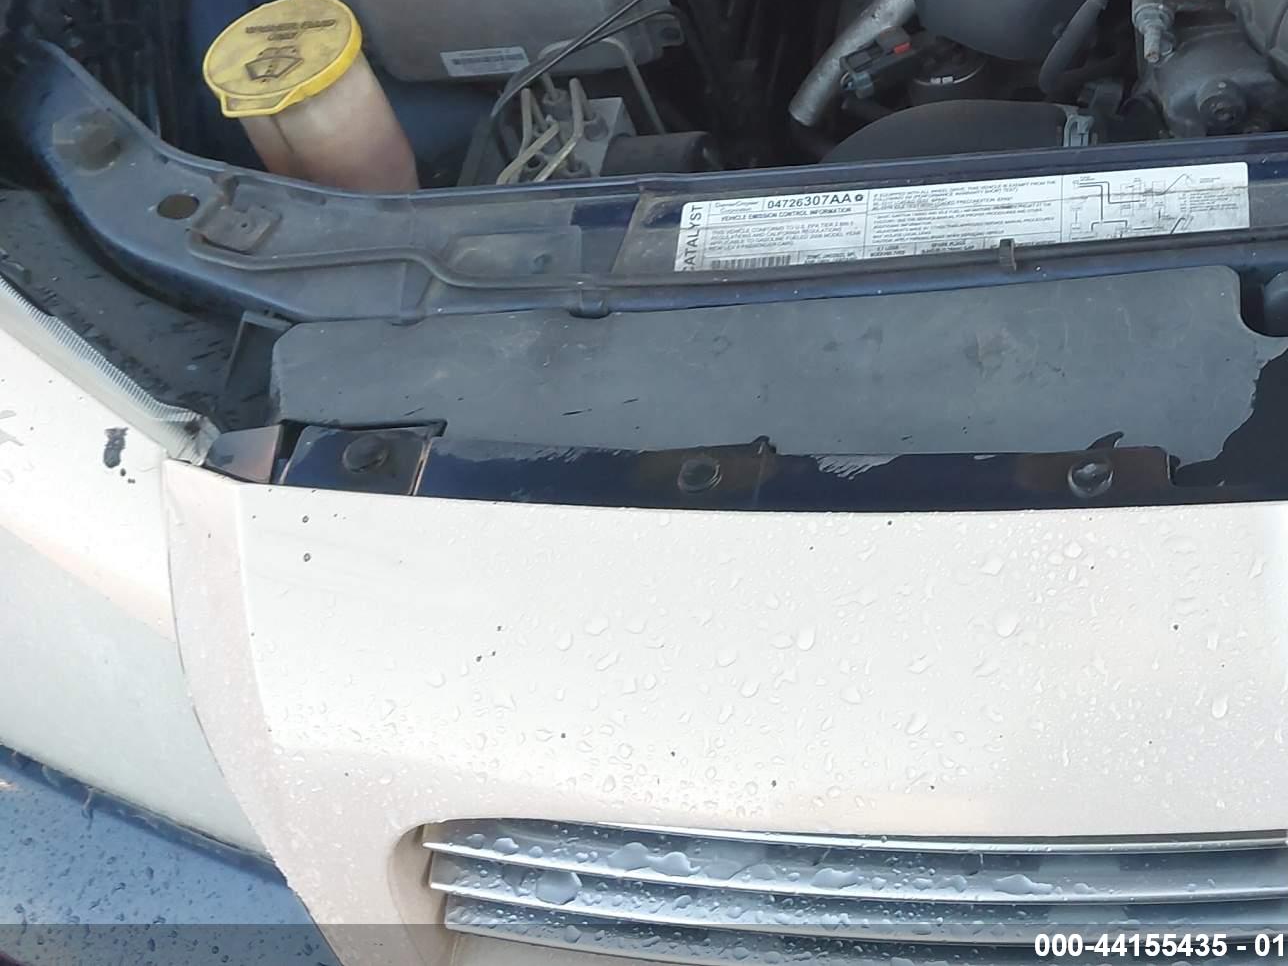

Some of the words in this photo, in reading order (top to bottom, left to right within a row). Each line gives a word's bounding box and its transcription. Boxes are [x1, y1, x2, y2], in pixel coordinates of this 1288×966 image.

[767, 193, 851, 209] 04726307AA
[721, 213, 746, 222] VEHICLE
[748, 211, 777, 220] EMISSION
[779, 209, 808, 218] CONTROL
[809, 207, 852, 216] INFORMATION
